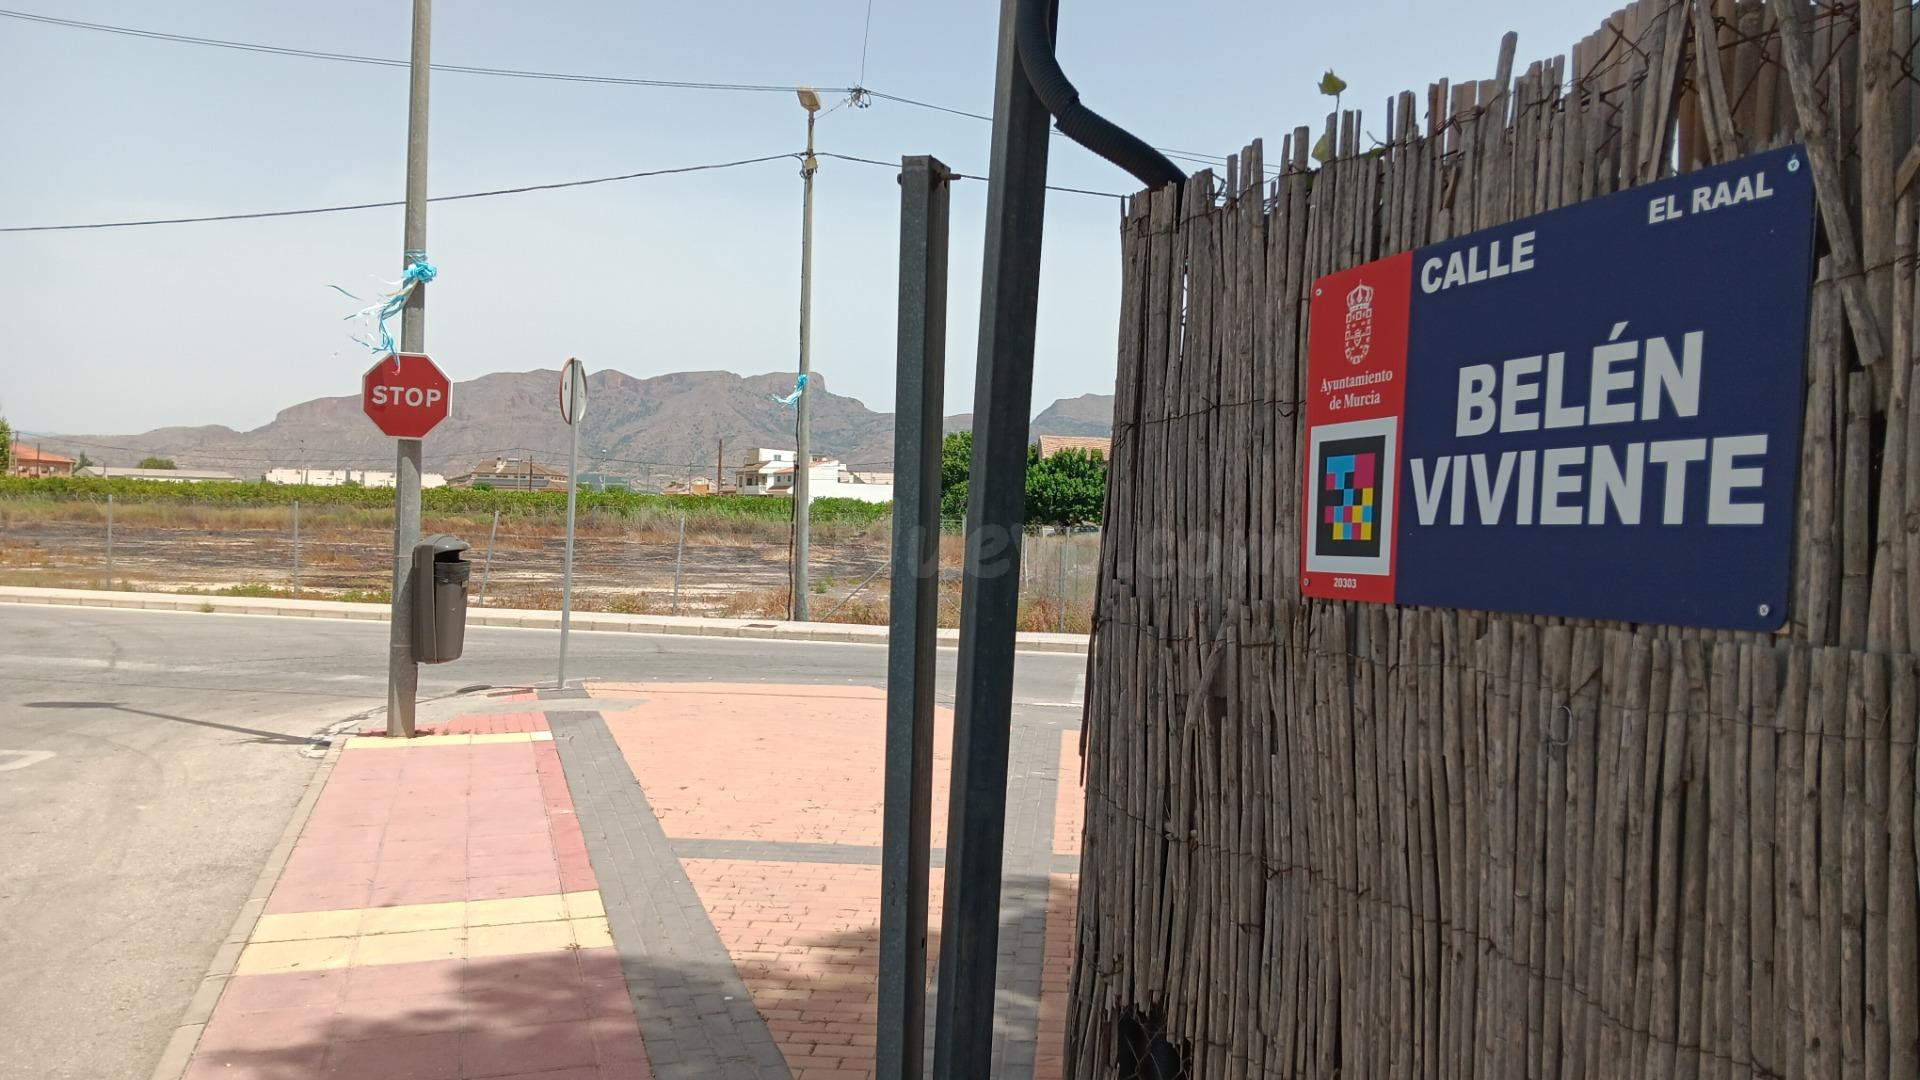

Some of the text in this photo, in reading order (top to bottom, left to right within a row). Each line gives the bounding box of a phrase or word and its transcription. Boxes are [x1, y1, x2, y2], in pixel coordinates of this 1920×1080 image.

[1648, 171, 1774, 225] EL RAAL
[1420, 231, 1536, 294] CALLE
[371, 385, 441, 408] STOP
[1320, 370, 1393, 395] Ayuntamiento
[1455, 321, 1705, 438] BELÉN
[1329, 390, 1380, 410] de Murcia
[1409, 434, 1769, 526] VIVIENTE
[1333, 577, 1357, 589] 20303
